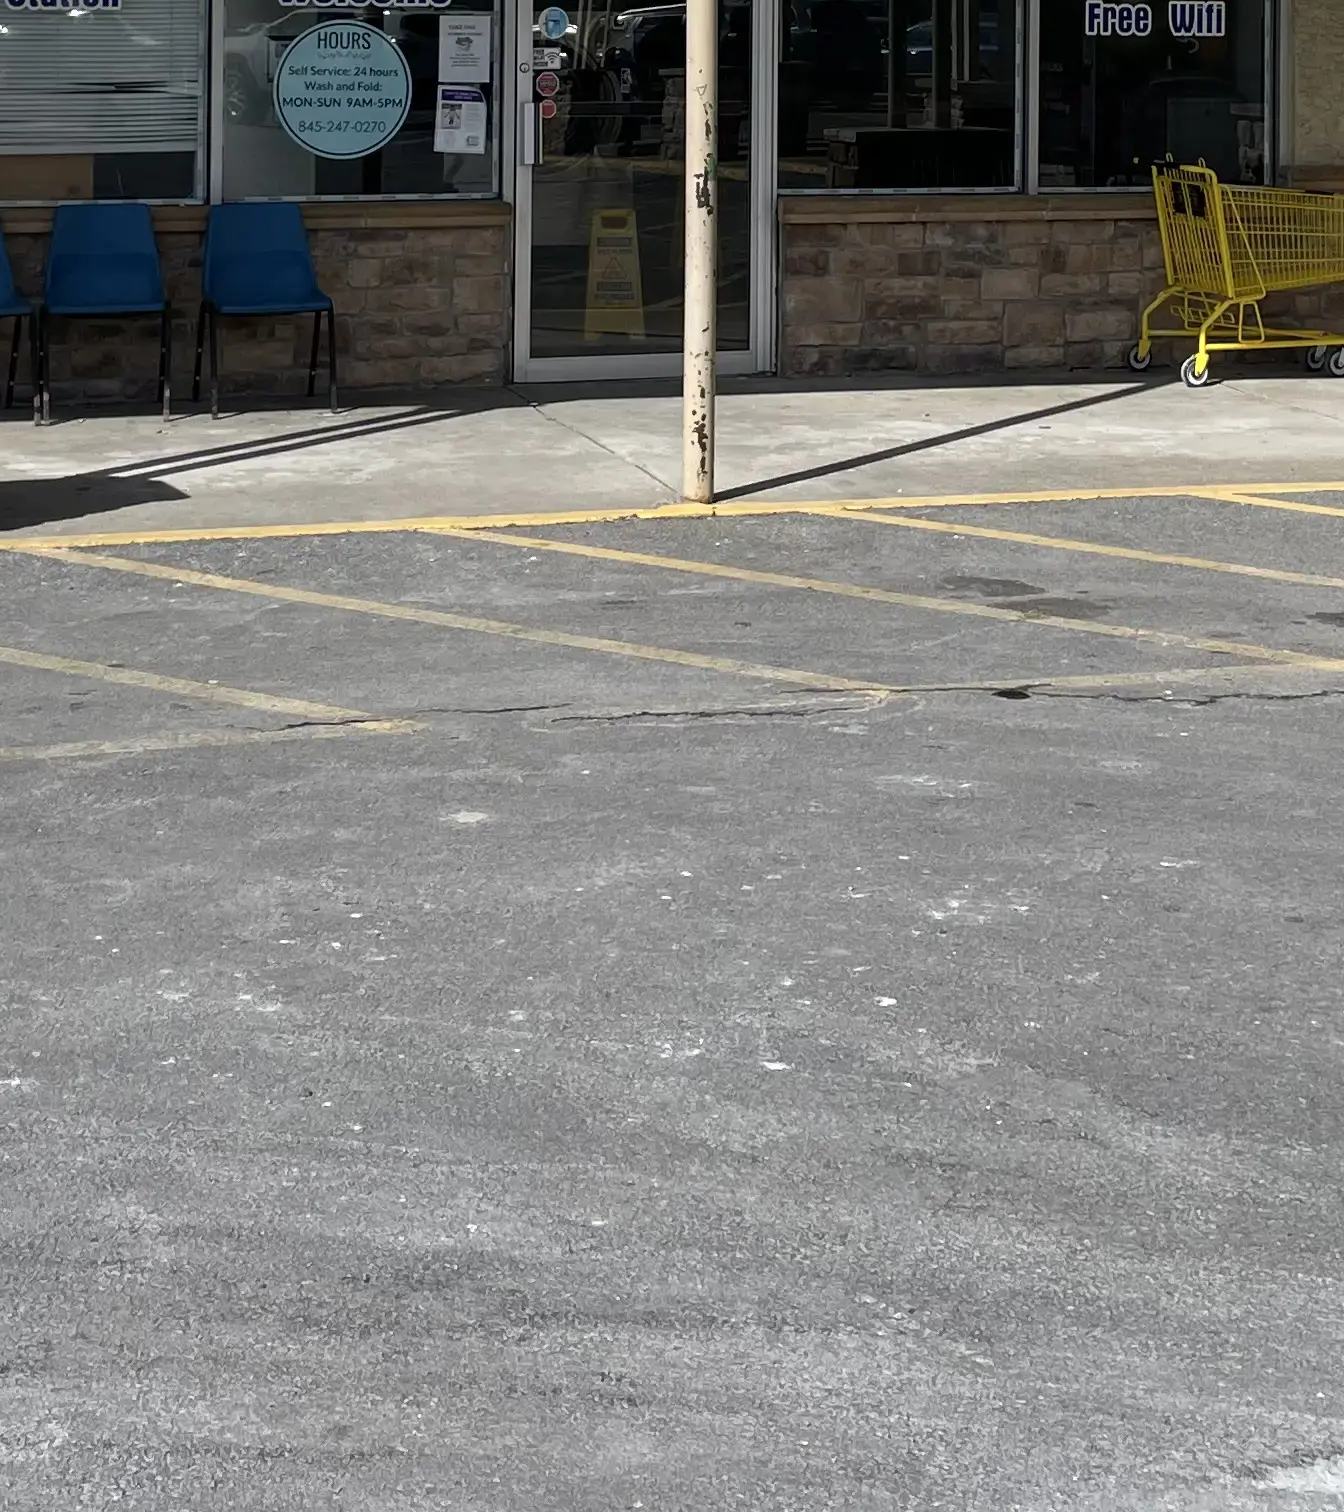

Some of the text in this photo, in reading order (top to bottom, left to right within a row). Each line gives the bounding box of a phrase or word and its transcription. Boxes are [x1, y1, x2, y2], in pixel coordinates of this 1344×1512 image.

[1086, 1, 1225, 37] Free Wifi
[318, 32, 371, 50] HOURS
[288, 65, 308, 76] Self
[353, 66, 367, 76] 24
[370, 67, 399, 77] hours
[304, 81, 334, 91] Wash
[336, 81, 355, 91] and
[283, 97, 403, 108] MON-SUN 9AM-5PM
[298, 120, 386, 133] 845-247-0270
